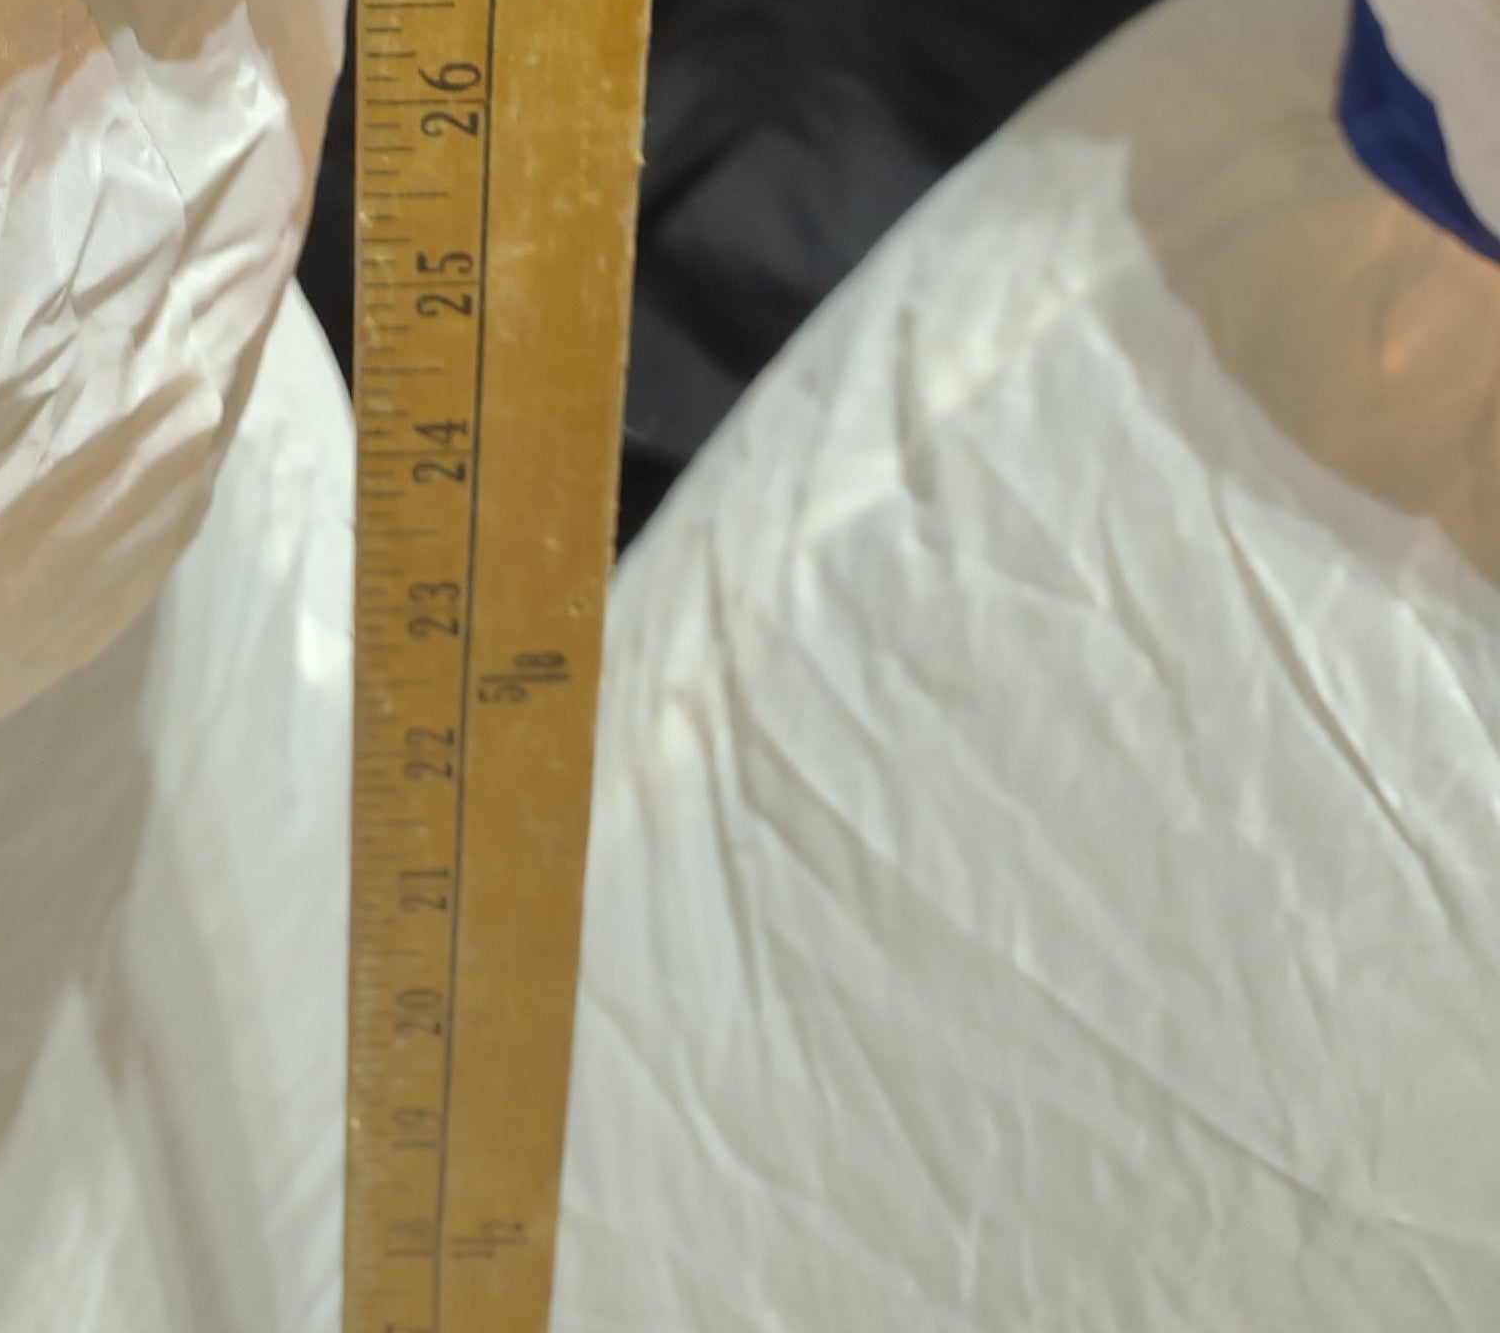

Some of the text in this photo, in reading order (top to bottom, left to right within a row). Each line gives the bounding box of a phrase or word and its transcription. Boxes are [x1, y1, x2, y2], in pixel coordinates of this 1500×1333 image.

[418, 61, 482, 137] 26
[416, 251, 473, 318] 25
[412, 417, 467, 485] 24
[408, 581, 460, 639] 23
[404, 727, 454, 779] 22
[399, 868, 448, 913] 21
[396, 988, 442, 1036] 20
